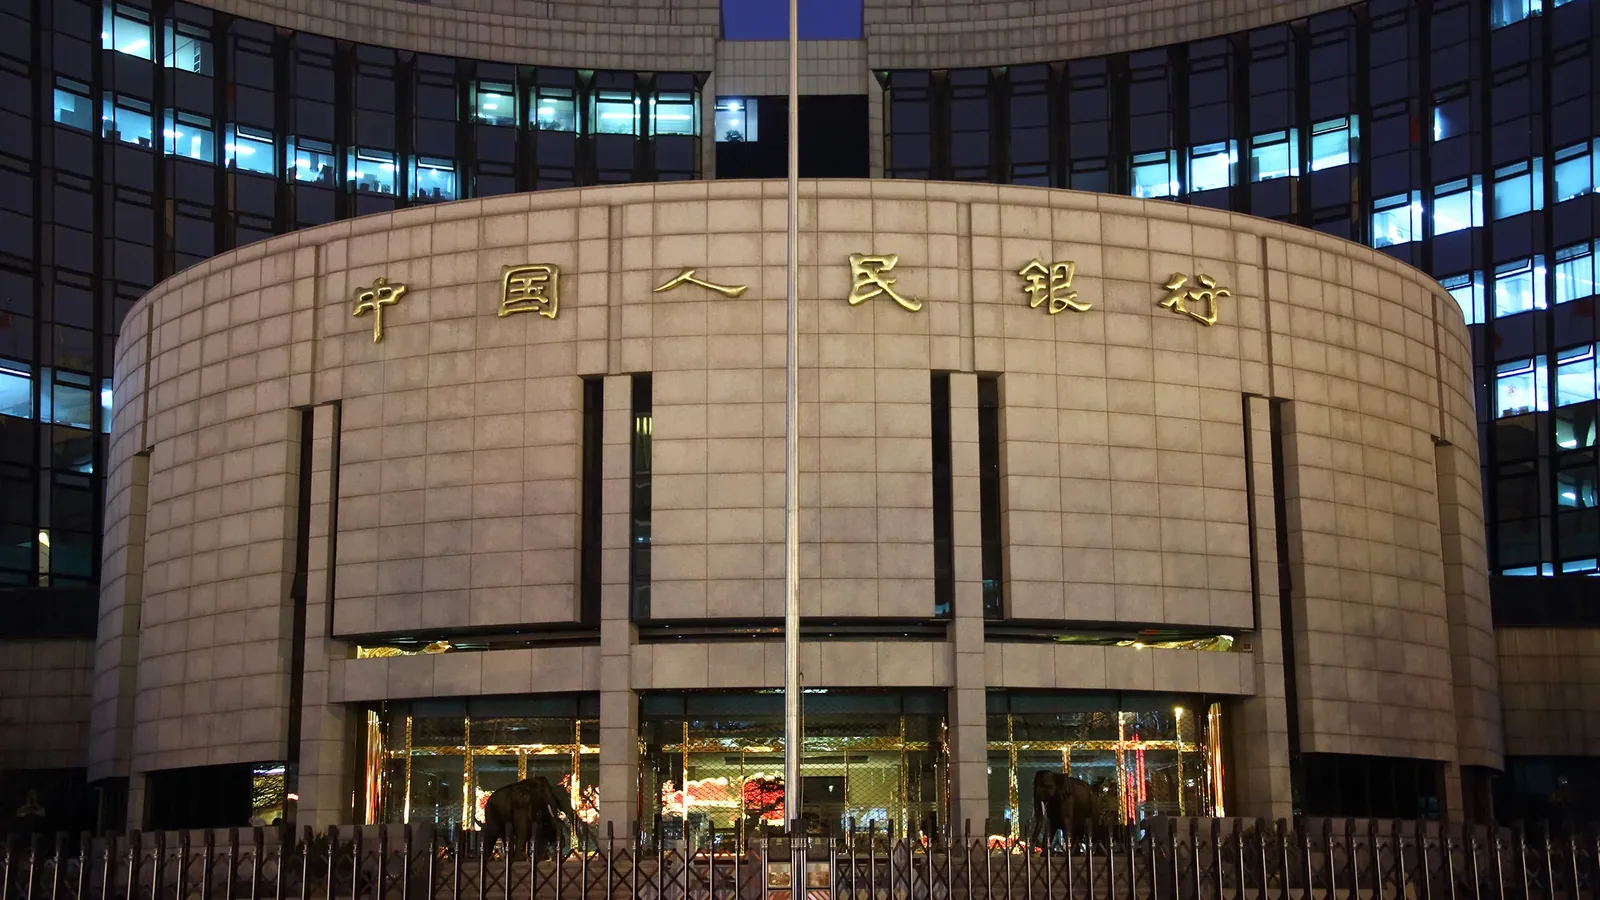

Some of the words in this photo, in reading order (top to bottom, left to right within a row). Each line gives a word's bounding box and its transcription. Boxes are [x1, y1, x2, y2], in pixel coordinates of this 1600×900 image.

[352, 253, 1231, 343] 中国人民银行
